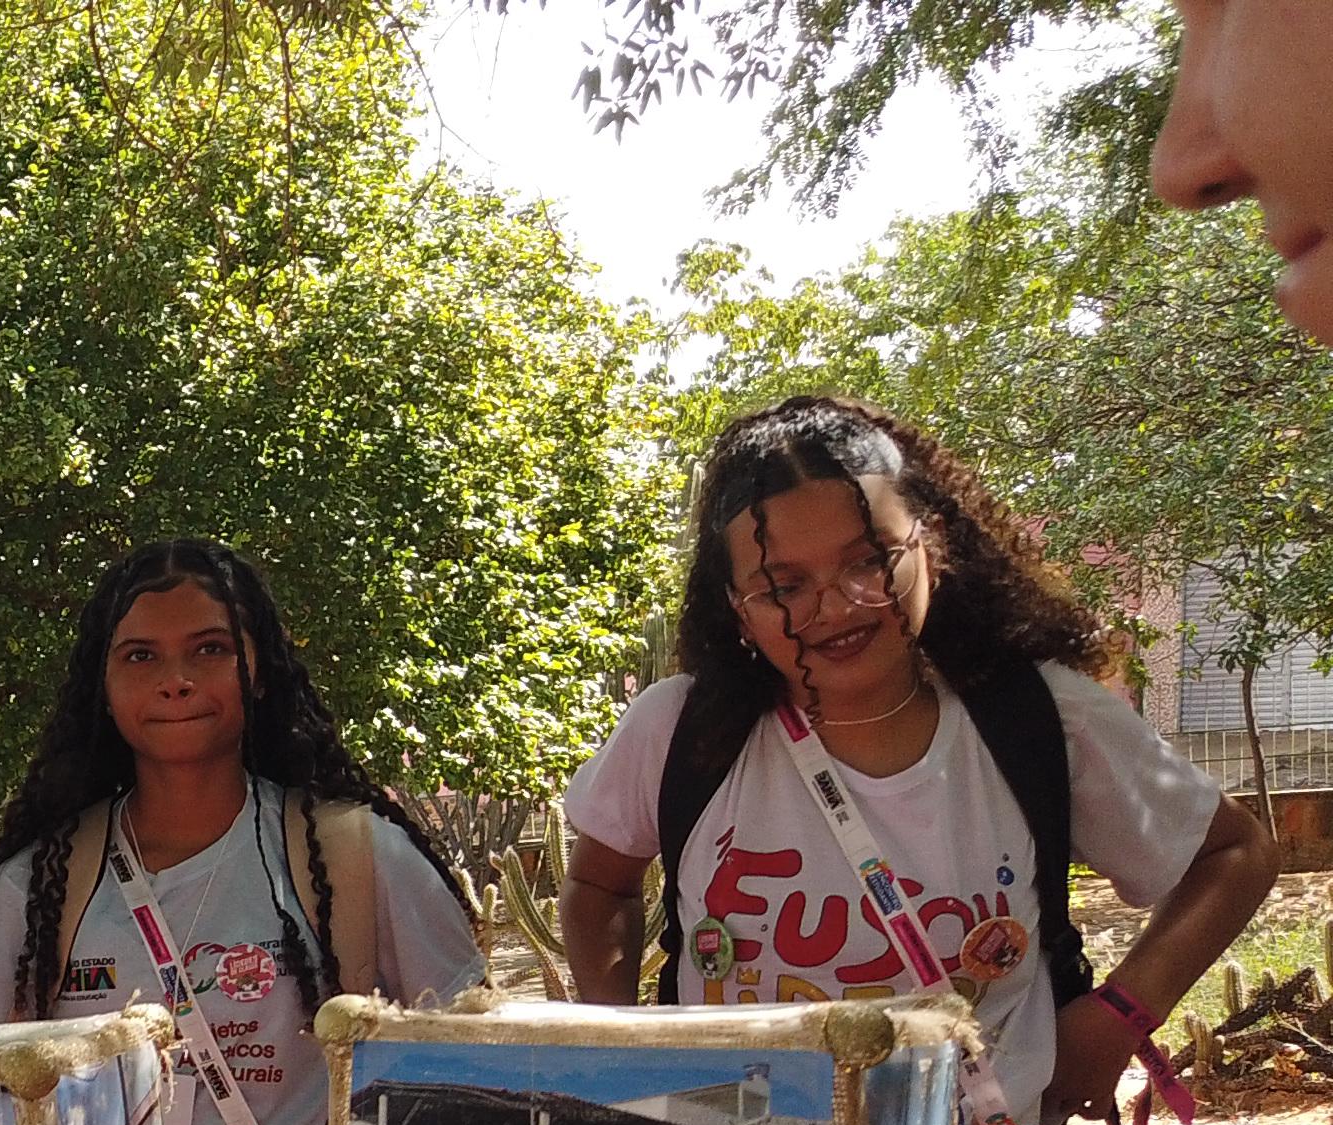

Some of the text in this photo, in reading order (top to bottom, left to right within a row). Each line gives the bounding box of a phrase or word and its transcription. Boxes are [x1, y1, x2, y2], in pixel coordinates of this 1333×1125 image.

[81, 957, 115, 966] ESTADO
[67, 966, 116, 992] HIA
[211, 1020, 258, 1041] jetos
[233, 1065, 283, 1083] urais
